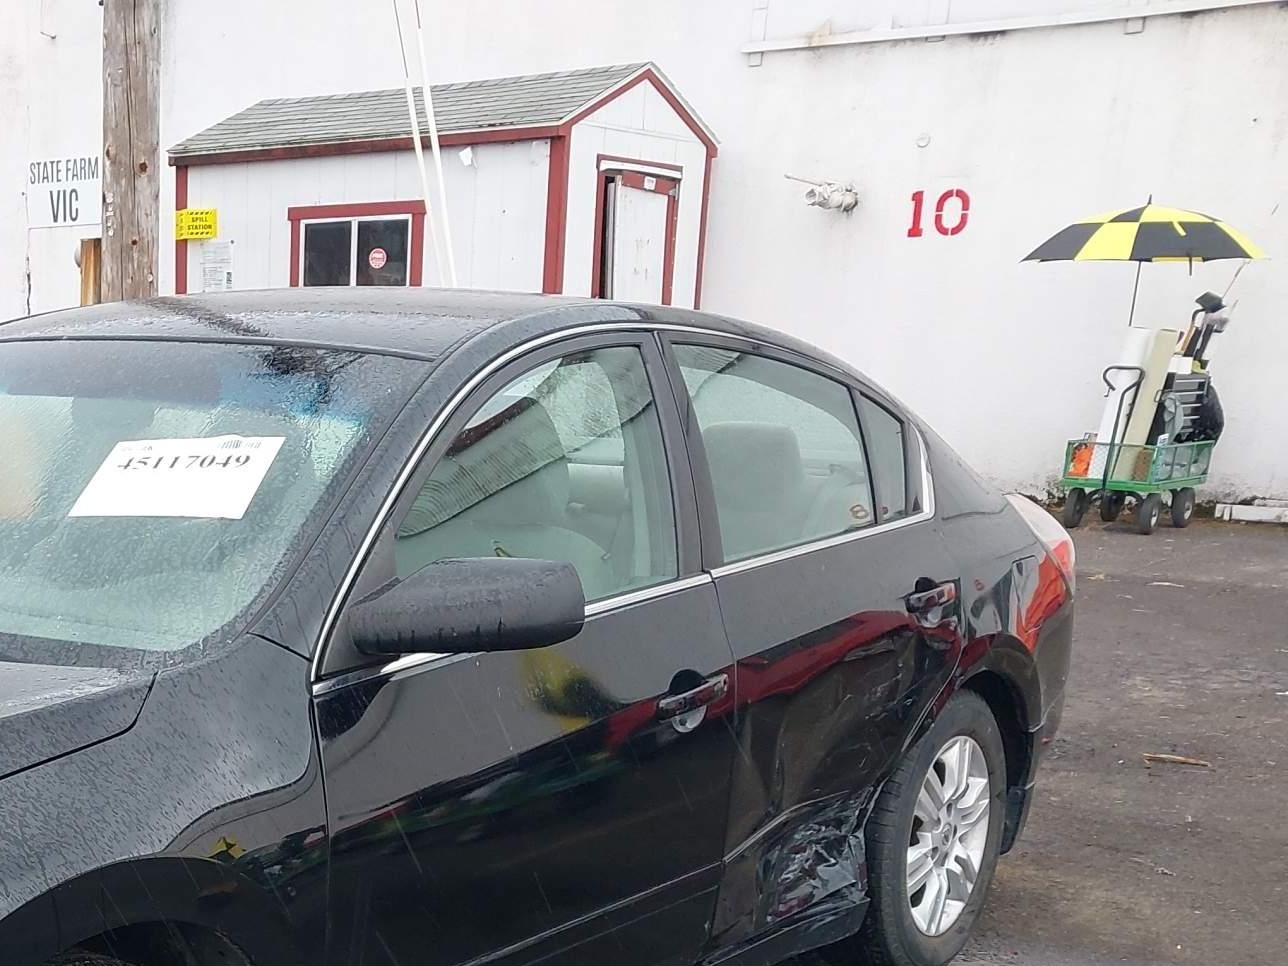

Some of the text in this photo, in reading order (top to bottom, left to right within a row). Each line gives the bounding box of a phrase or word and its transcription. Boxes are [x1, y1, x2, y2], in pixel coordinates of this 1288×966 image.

[29, 156, 99, 184] STATE FARM
[50, 188, 79, 223] VIC
[906, 188, 971, 238] 10
[118, 455, 251, 470] 45117049
